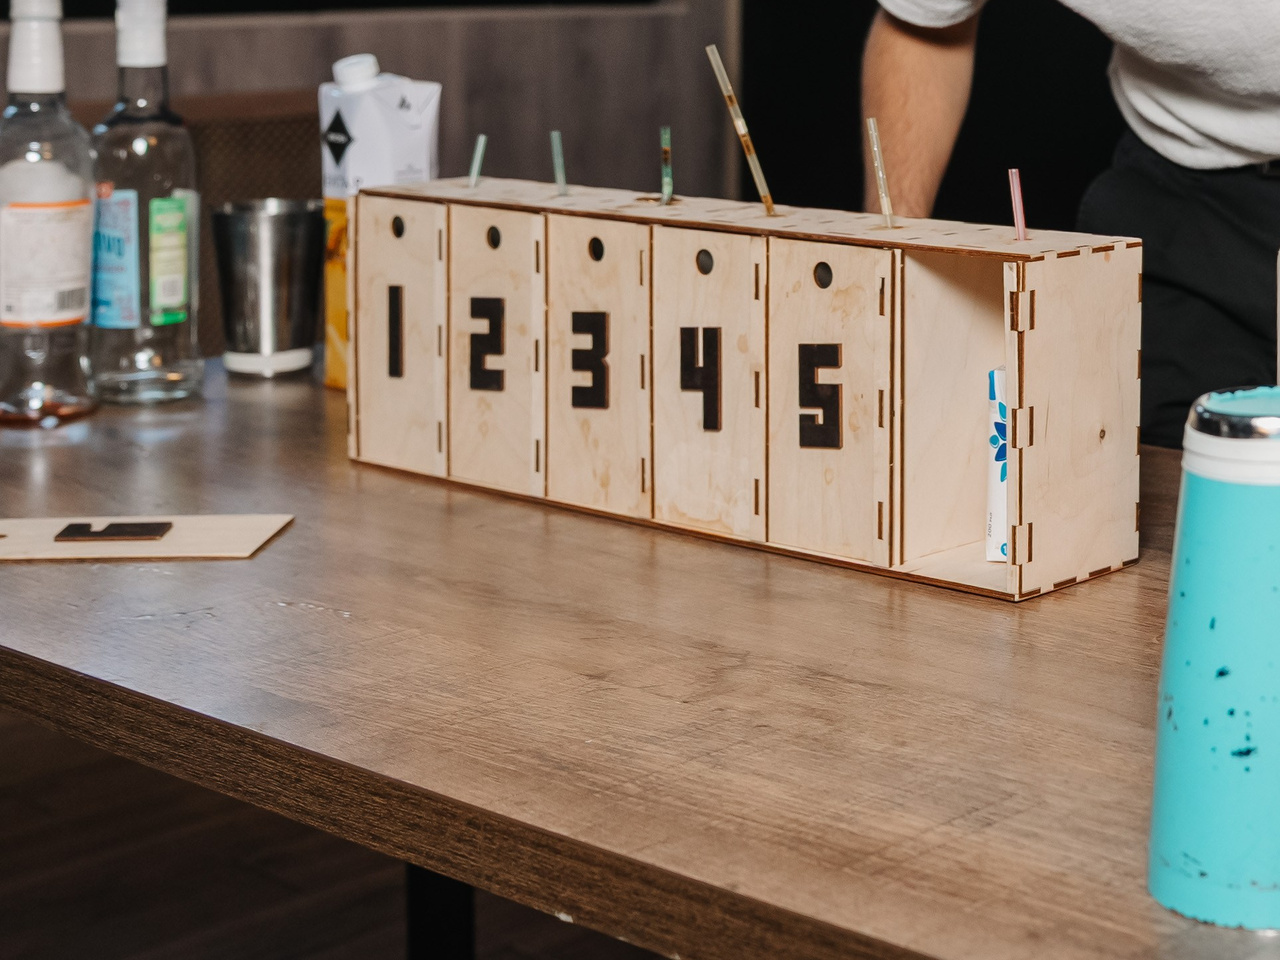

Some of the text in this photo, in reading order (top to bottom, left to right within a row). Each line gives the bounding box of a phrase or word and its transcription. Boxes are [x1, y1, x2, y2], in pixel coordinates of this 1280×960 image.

[388, 285, 403, 378] 1
[470, 297, 504, 391] 2
[571, 311, 610, 409] 3
[679, 326, 721, 432] 4
[798, 342, 843, 448] 5
